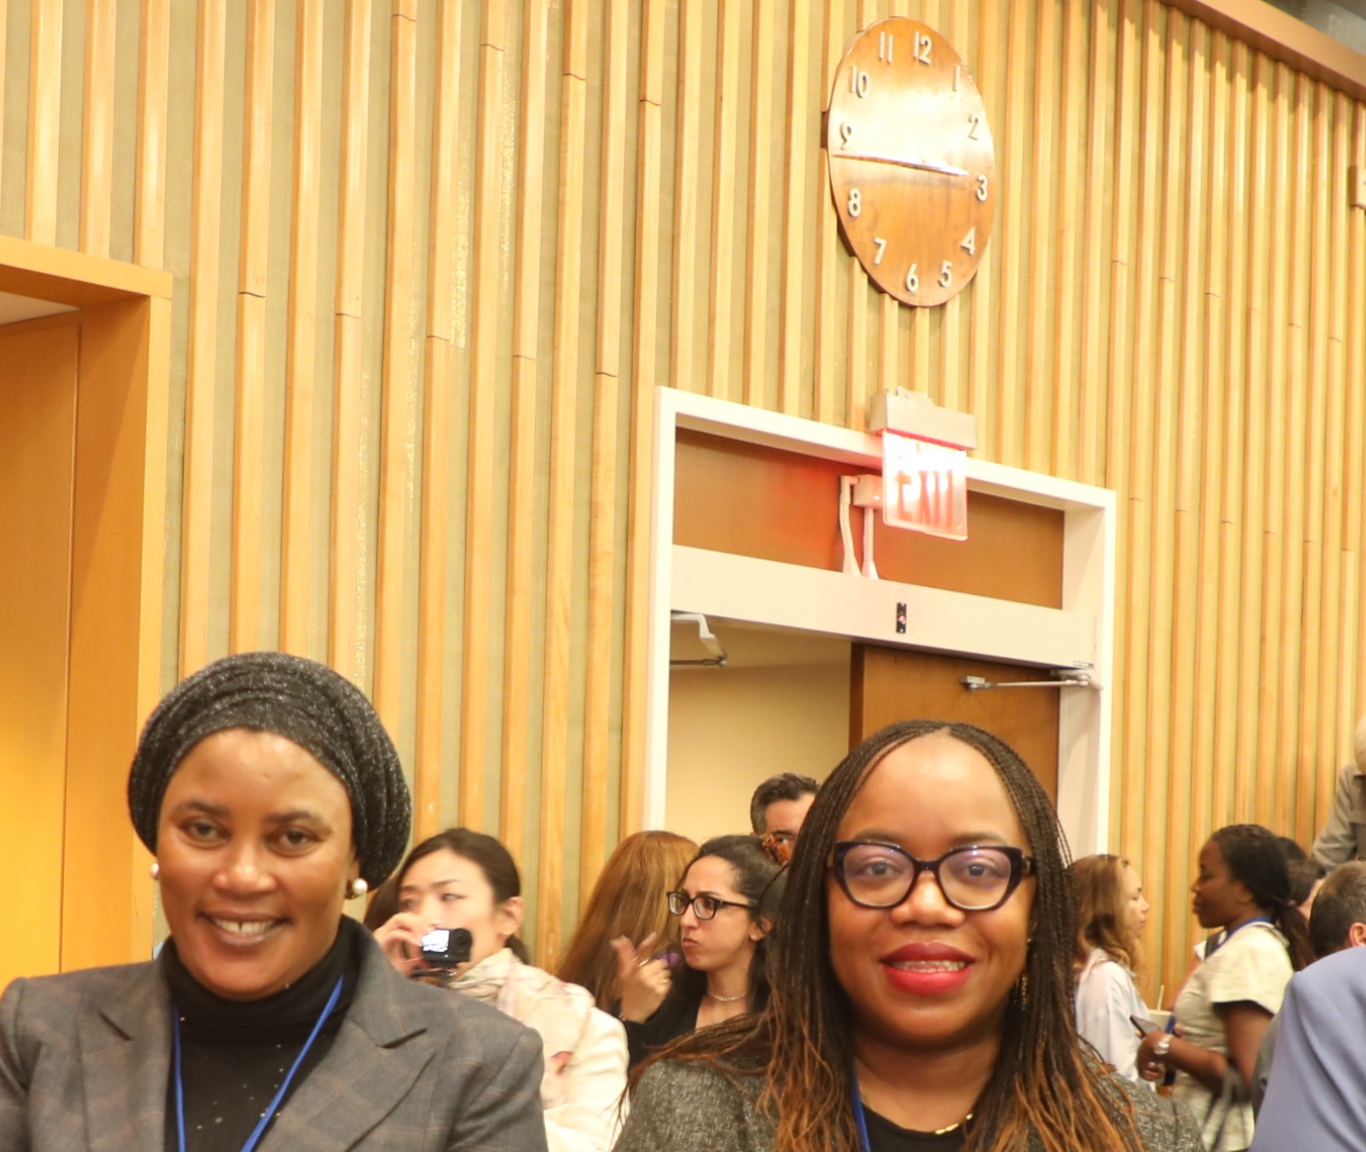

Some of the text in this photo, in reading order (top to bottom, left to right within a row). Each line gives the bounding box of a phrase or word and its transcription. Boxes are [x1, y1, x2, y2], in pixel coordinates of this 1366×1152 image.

[879, 31, 893, 63] 11
[914, 31, 932, 66] 12
[849, 65, 870, 99] 10
[953, 65, 961, 92] 1
[840, 122, 852, 150] 9
[968, 114, 979, 140] 2
[976, 175, 988, 201] 3
[848, 188, 861, 217] 8
[874, 237, 887, 264] 7
[960, 227, 976, 255] 4
[906, 263, 919, 293] 6
[937, 260, 953, 288] 5
